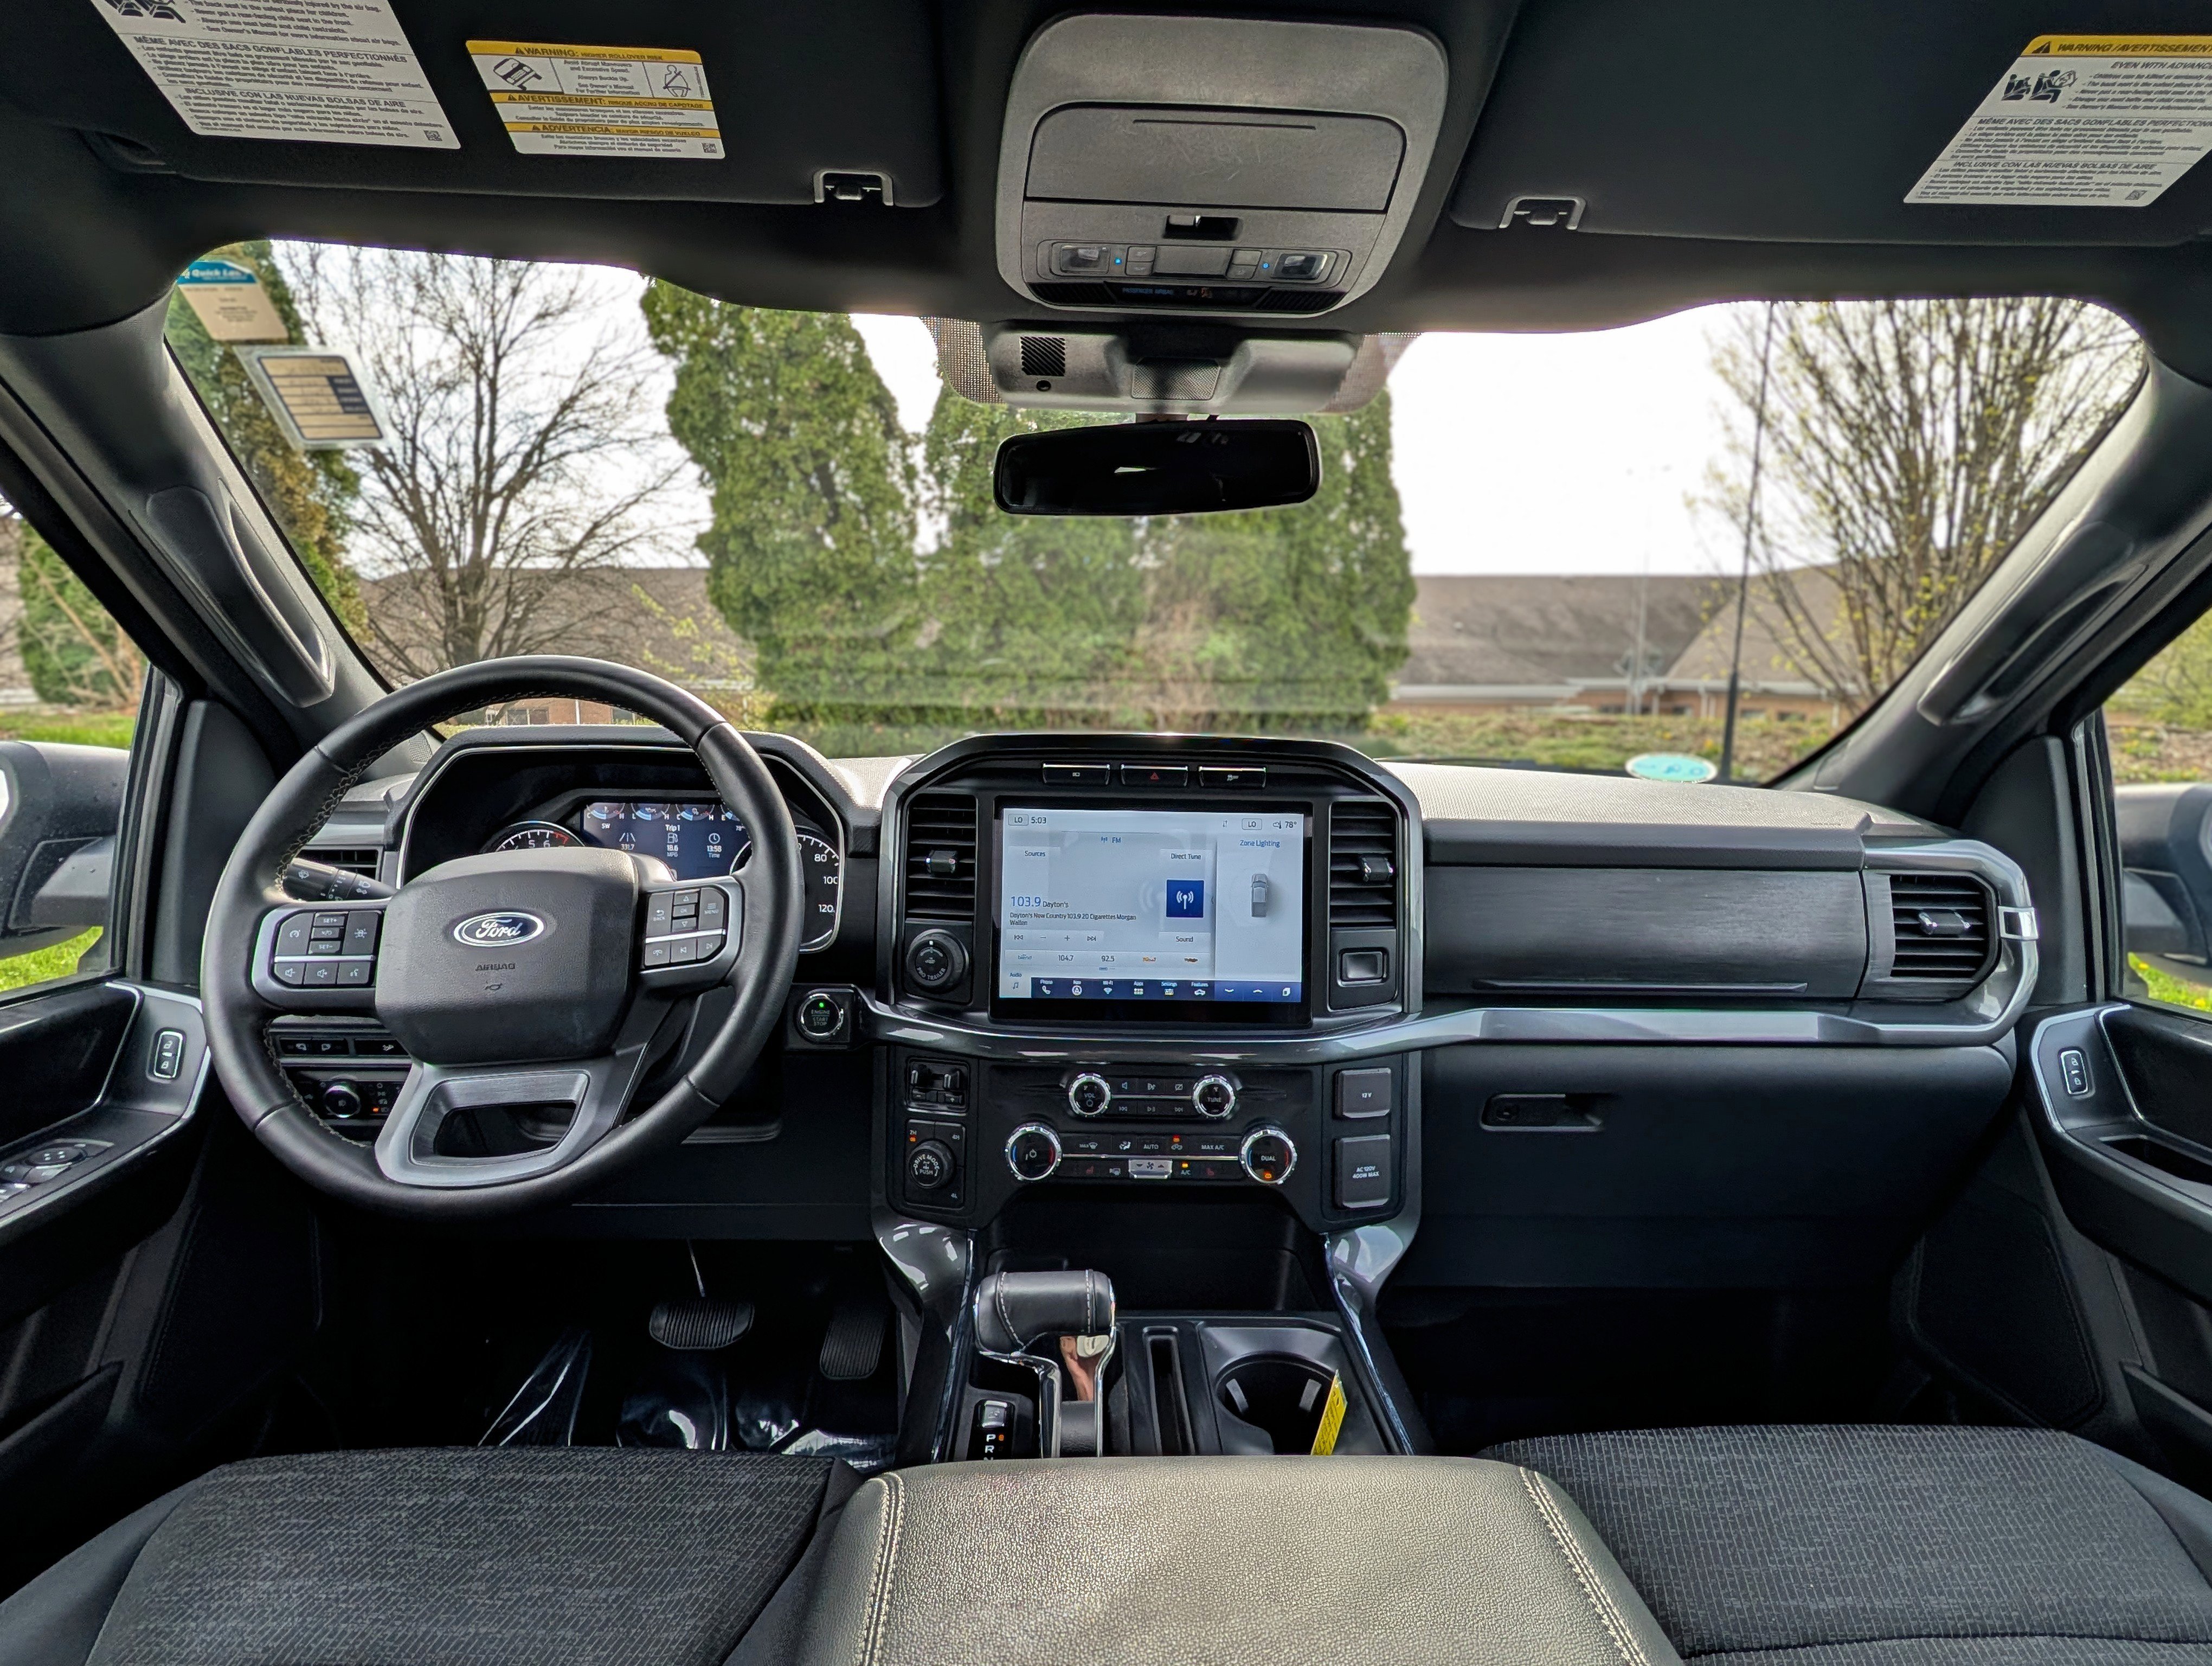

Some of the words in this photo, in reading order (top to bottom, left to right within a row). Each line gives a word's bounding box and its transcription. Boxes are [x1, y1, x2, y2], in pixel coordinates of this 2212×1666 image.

[169, 39, 196, 48] AVEC
[2140, 61, 2168, 69] WITH
[285, 93, 325, 102] NUEVAS
[528, 840, 536, 848] 5
[543, 840, 551, 848] 6
[1256, 840, 1281, 848] Lighting
[814, 854, 827, 862] 80
[824, 876, 838, 885] 100
[1011, 896, 1041, 907] 103.9
[1043, 901, 1069, 909] Dayton's
[818, 904, 834, 913] 120
[475, 919, 523, 938] Ford
[475, 963, 516, 971] AIRBAG
[917, 967, 926, 978] PRO
[927, 967, 946, 980] TRAILER
[913, 1154, 927, 1168] DRIVE
[927, 1154, 940, 1170] MODE
[986, 1434, 996, 1443] P
[985, 1445, 995, 1453] R
